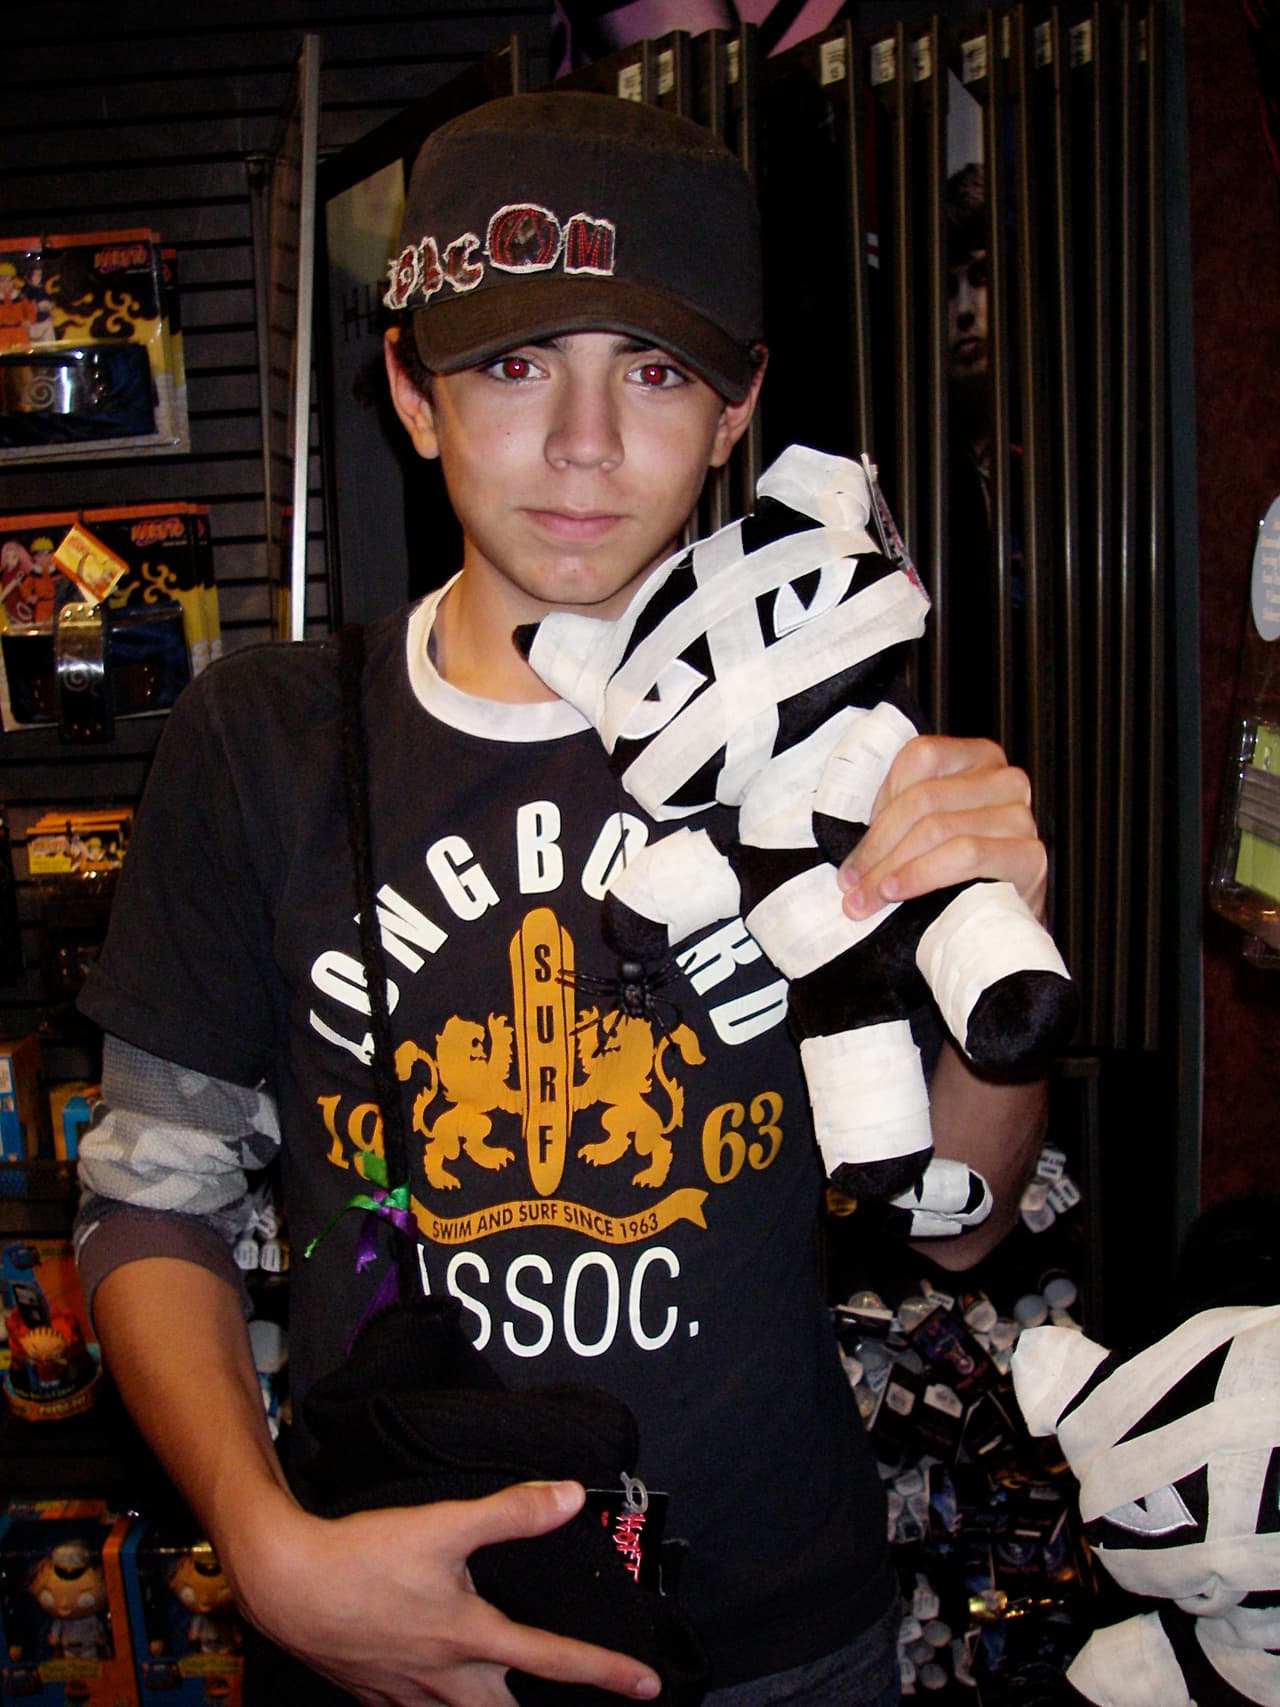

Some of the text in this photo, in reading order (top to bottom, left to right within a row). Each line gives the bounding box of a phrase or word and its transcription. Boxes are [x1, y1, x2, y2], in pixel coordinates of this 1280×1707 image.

[309, 800, 789, 1066] LONGBORD
[533, 943, 557, 1164] SURF
[701, 1091, 784, 1184] 63
[432, 1203, 660, 1240] SWIM AND SURF SINCE 1963
[416, 1243, 700, 1357] SSOC.
